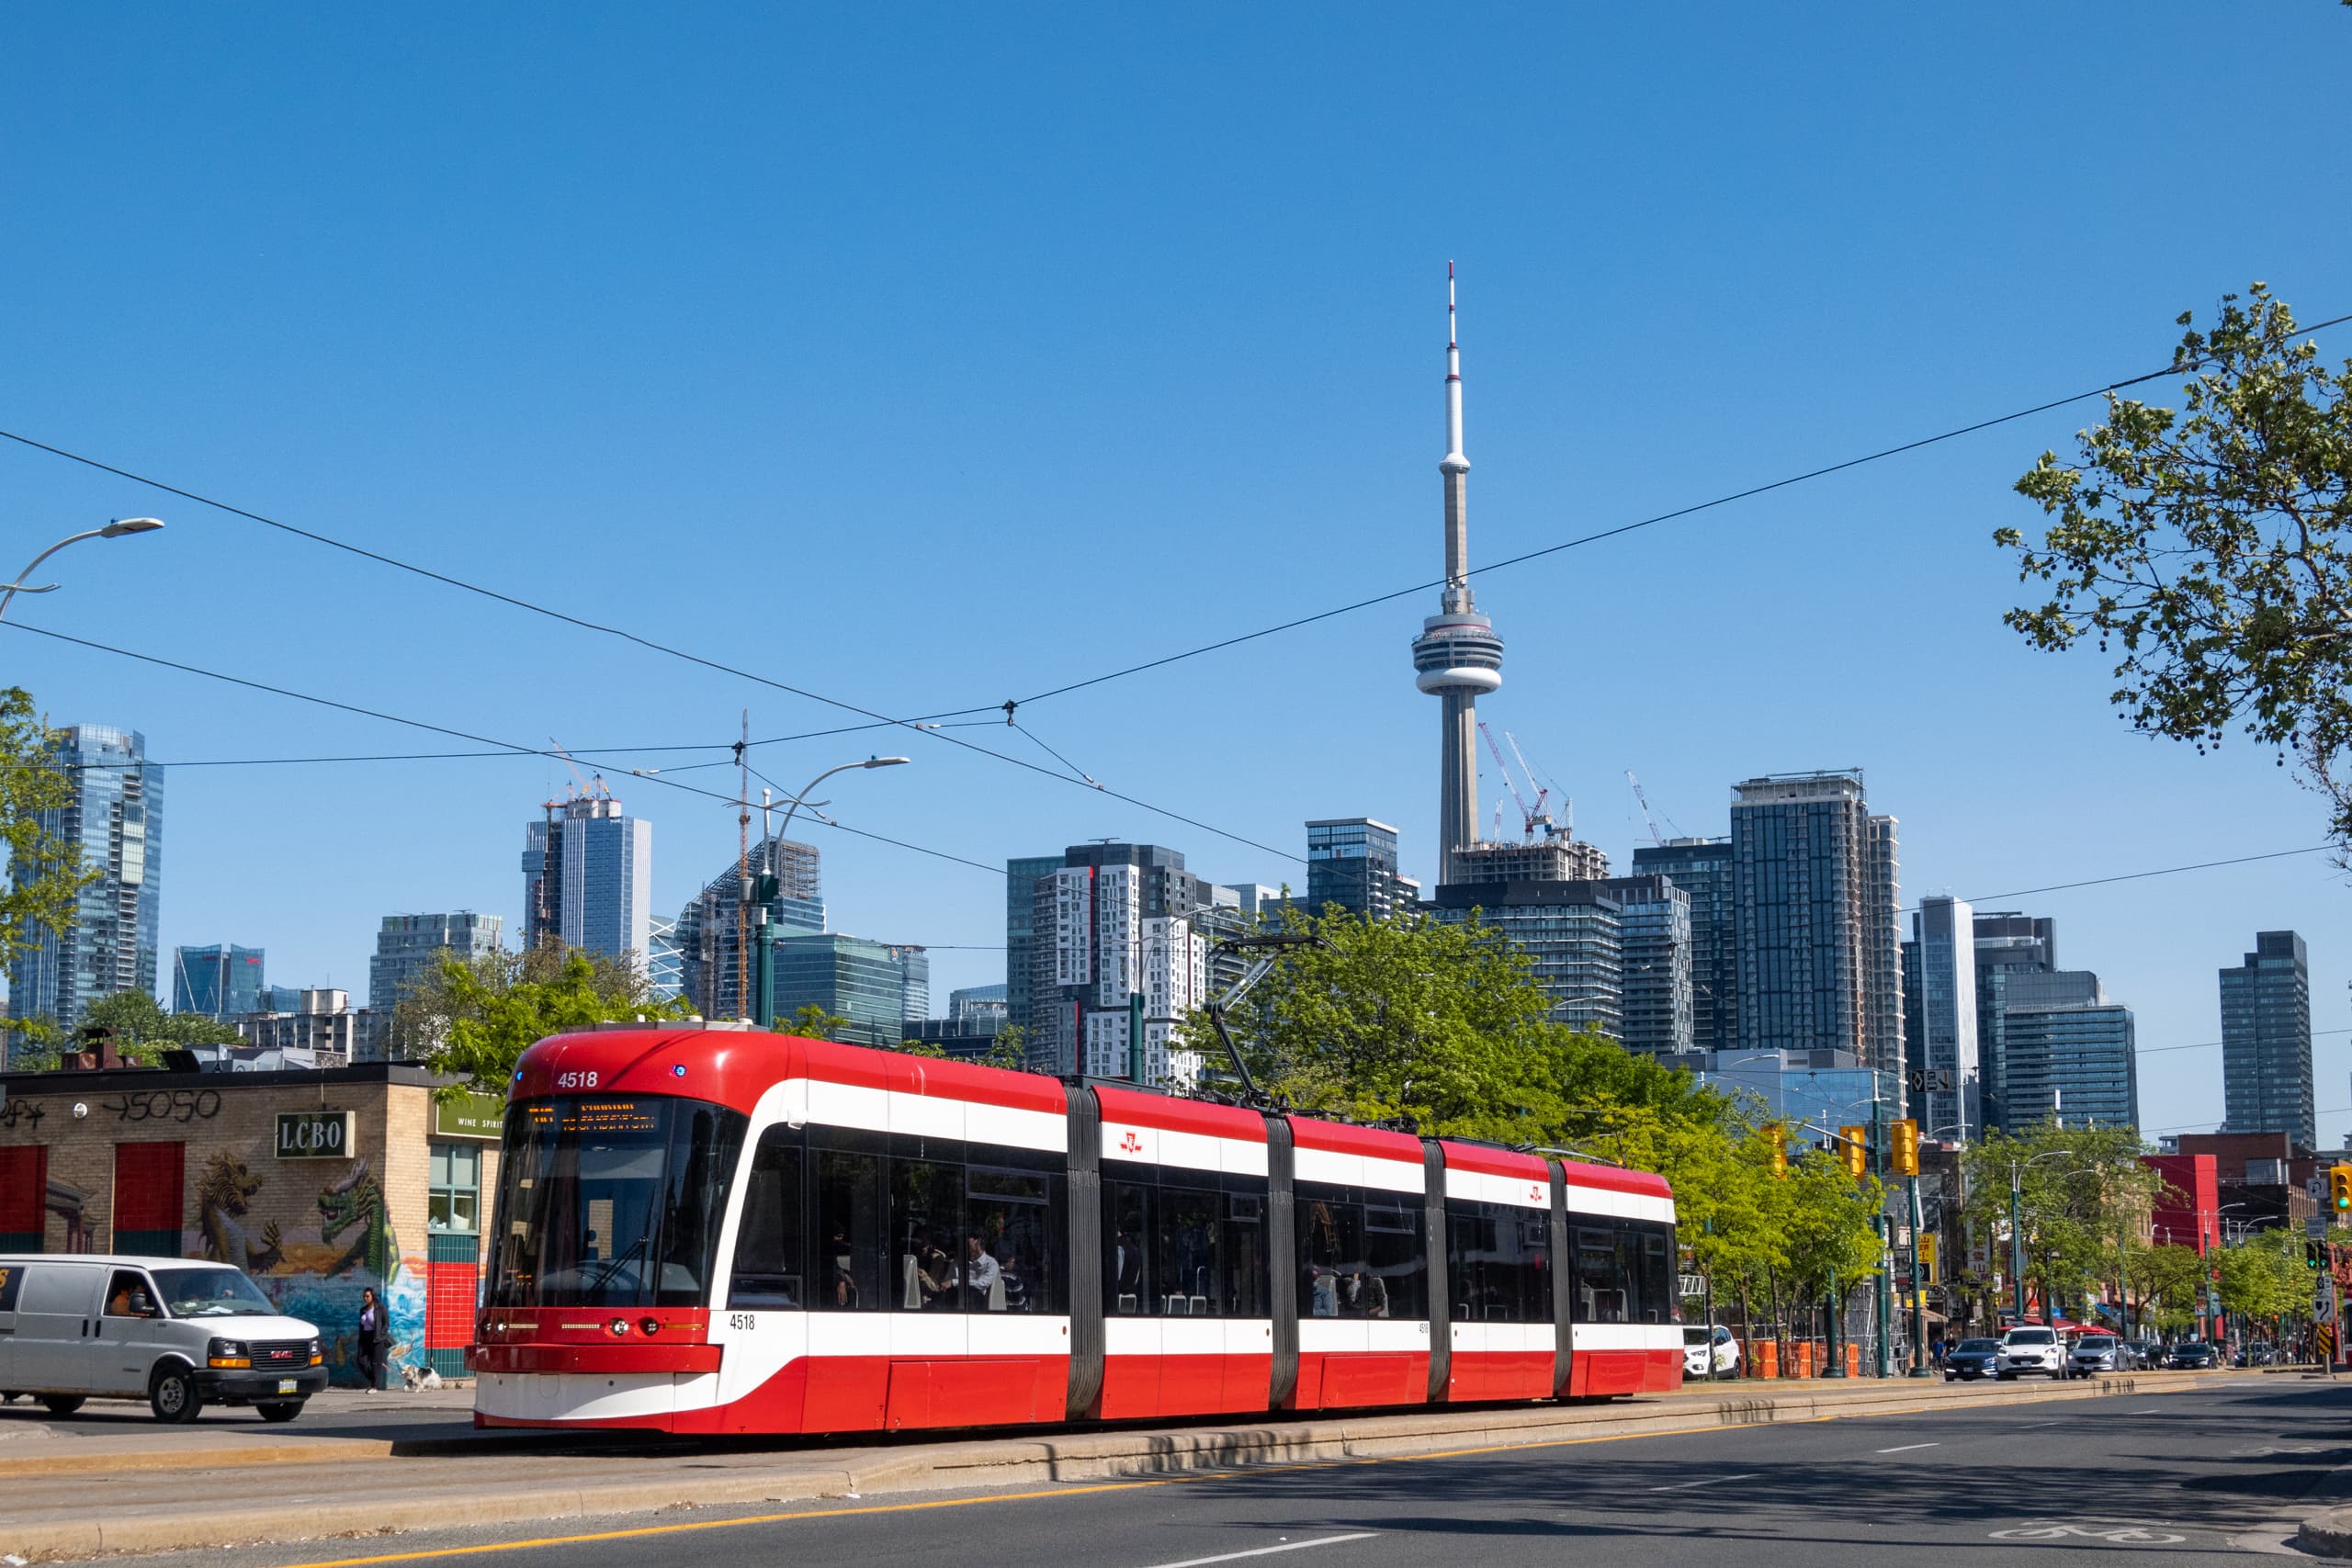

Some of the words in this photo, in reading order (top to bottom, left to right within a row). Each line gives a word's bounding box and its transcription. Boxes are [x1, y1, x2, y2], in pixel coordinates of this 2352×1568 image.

[558, 1071, 598, 1089] 4518
[458, 1117, 477, 1127] WINE
[280, 1121, 341, 1149] LCBO
[730, 1314, 755, 1330] 4518
